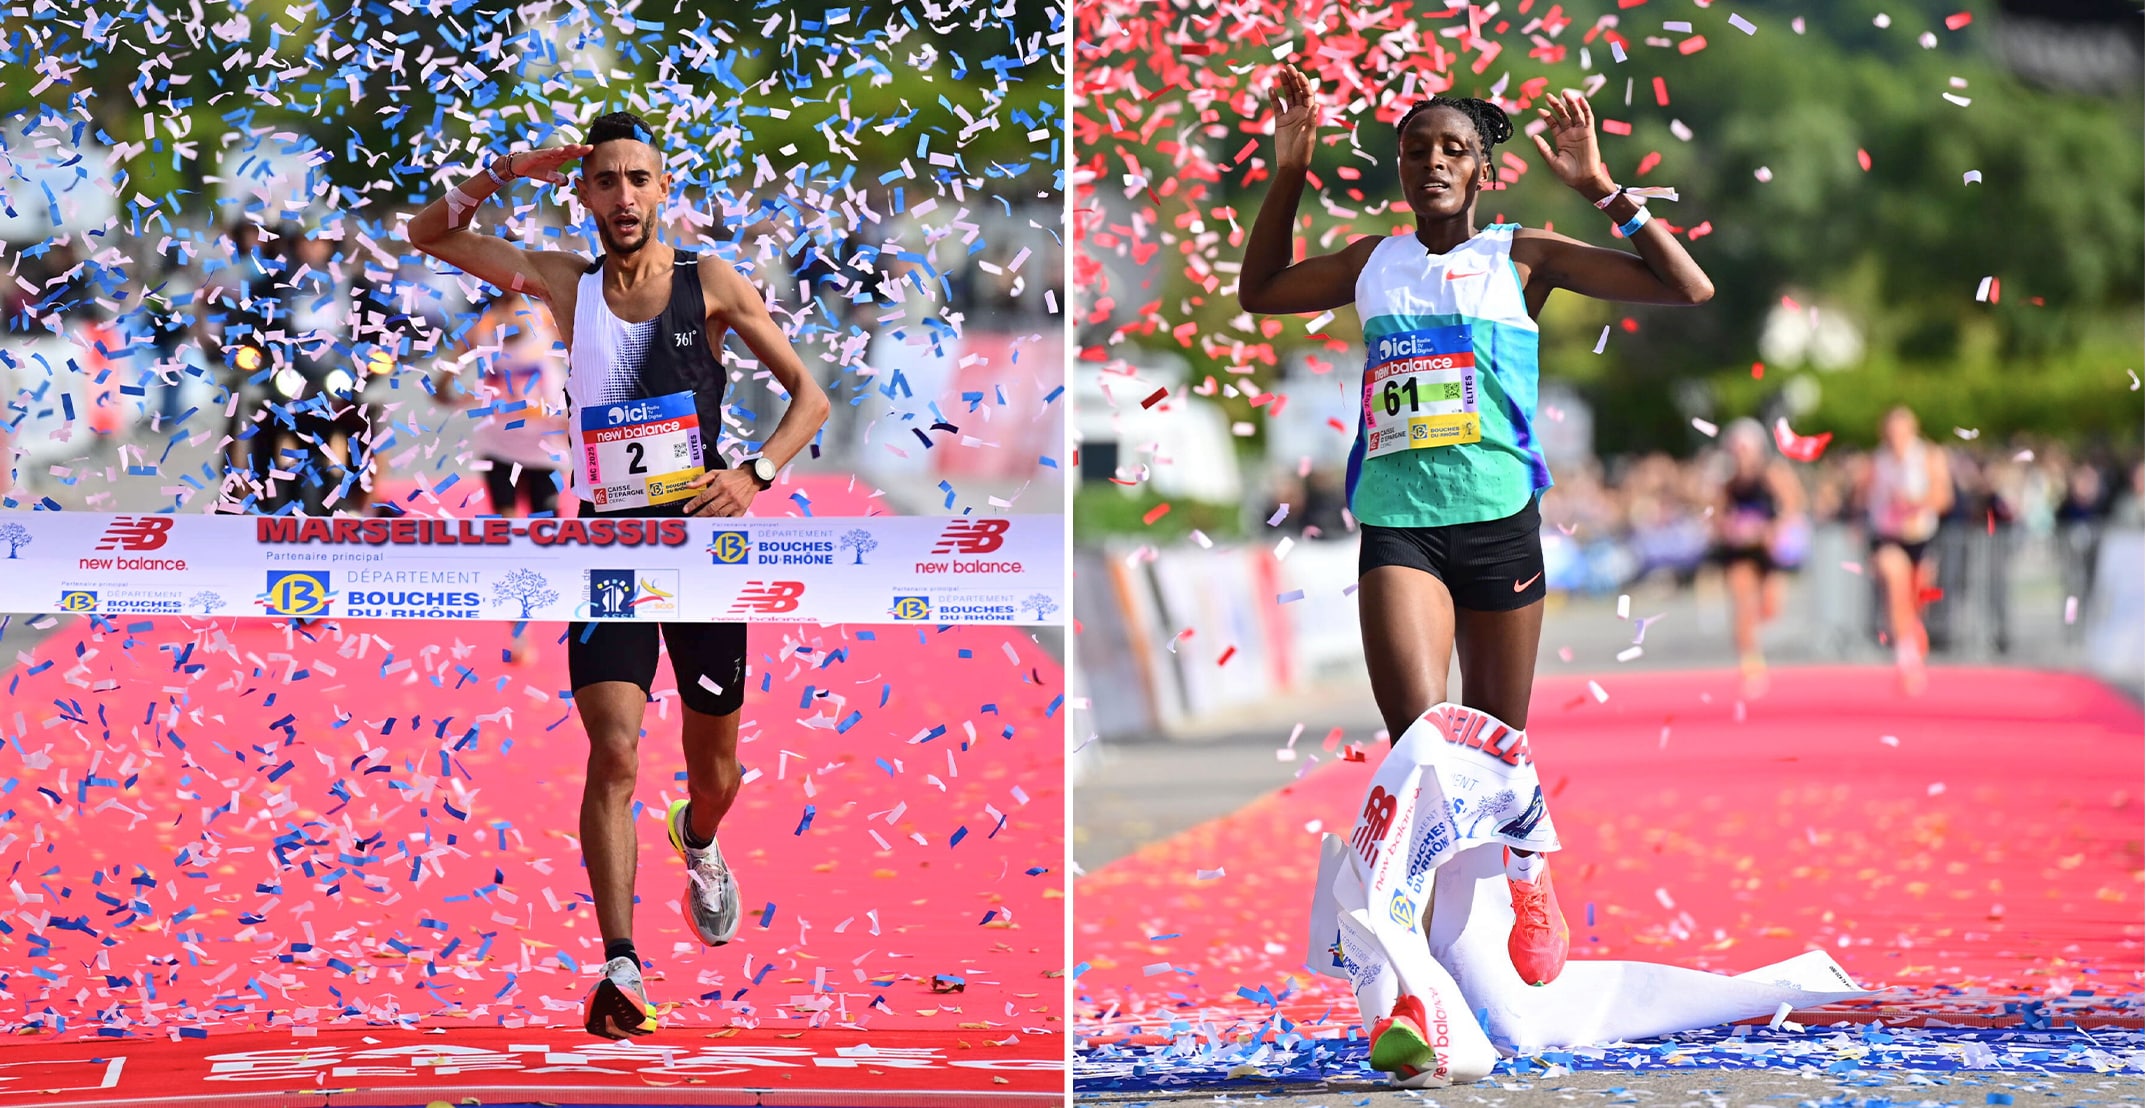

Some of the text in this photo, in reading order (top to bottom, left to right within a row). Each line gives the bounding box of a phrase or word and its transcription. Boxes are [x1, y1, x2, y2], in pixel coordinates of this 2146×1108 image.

[1393, 335, 1417, 357] ici
[1374, 357, 1453, 381] new balance
[1384, 377, 1419, 416] 61
[1465, 375, 1474, 405] ELITES
[624, 403, 648, 423] ici
[597, 420, 680, 442] new balance
[626, 442, 648, 475] 2
[690, 434, 700, 460] ELITES
[589, 446, 598, 481] MC 2025
[608, 484, 632, 493] CAISSE
[257, 517, 688, 547] MARSEILLE-CASSIS
[79, 558, 113, 570] new
[266, 552, 384, 562] Partenaire principal
[915, 561, 949, 574] new
[347, 568, 481, 584] DÉPARTEMENT
[1375, 857, 1389, 892] new
[1432, 1051, 1449, 1081] new
